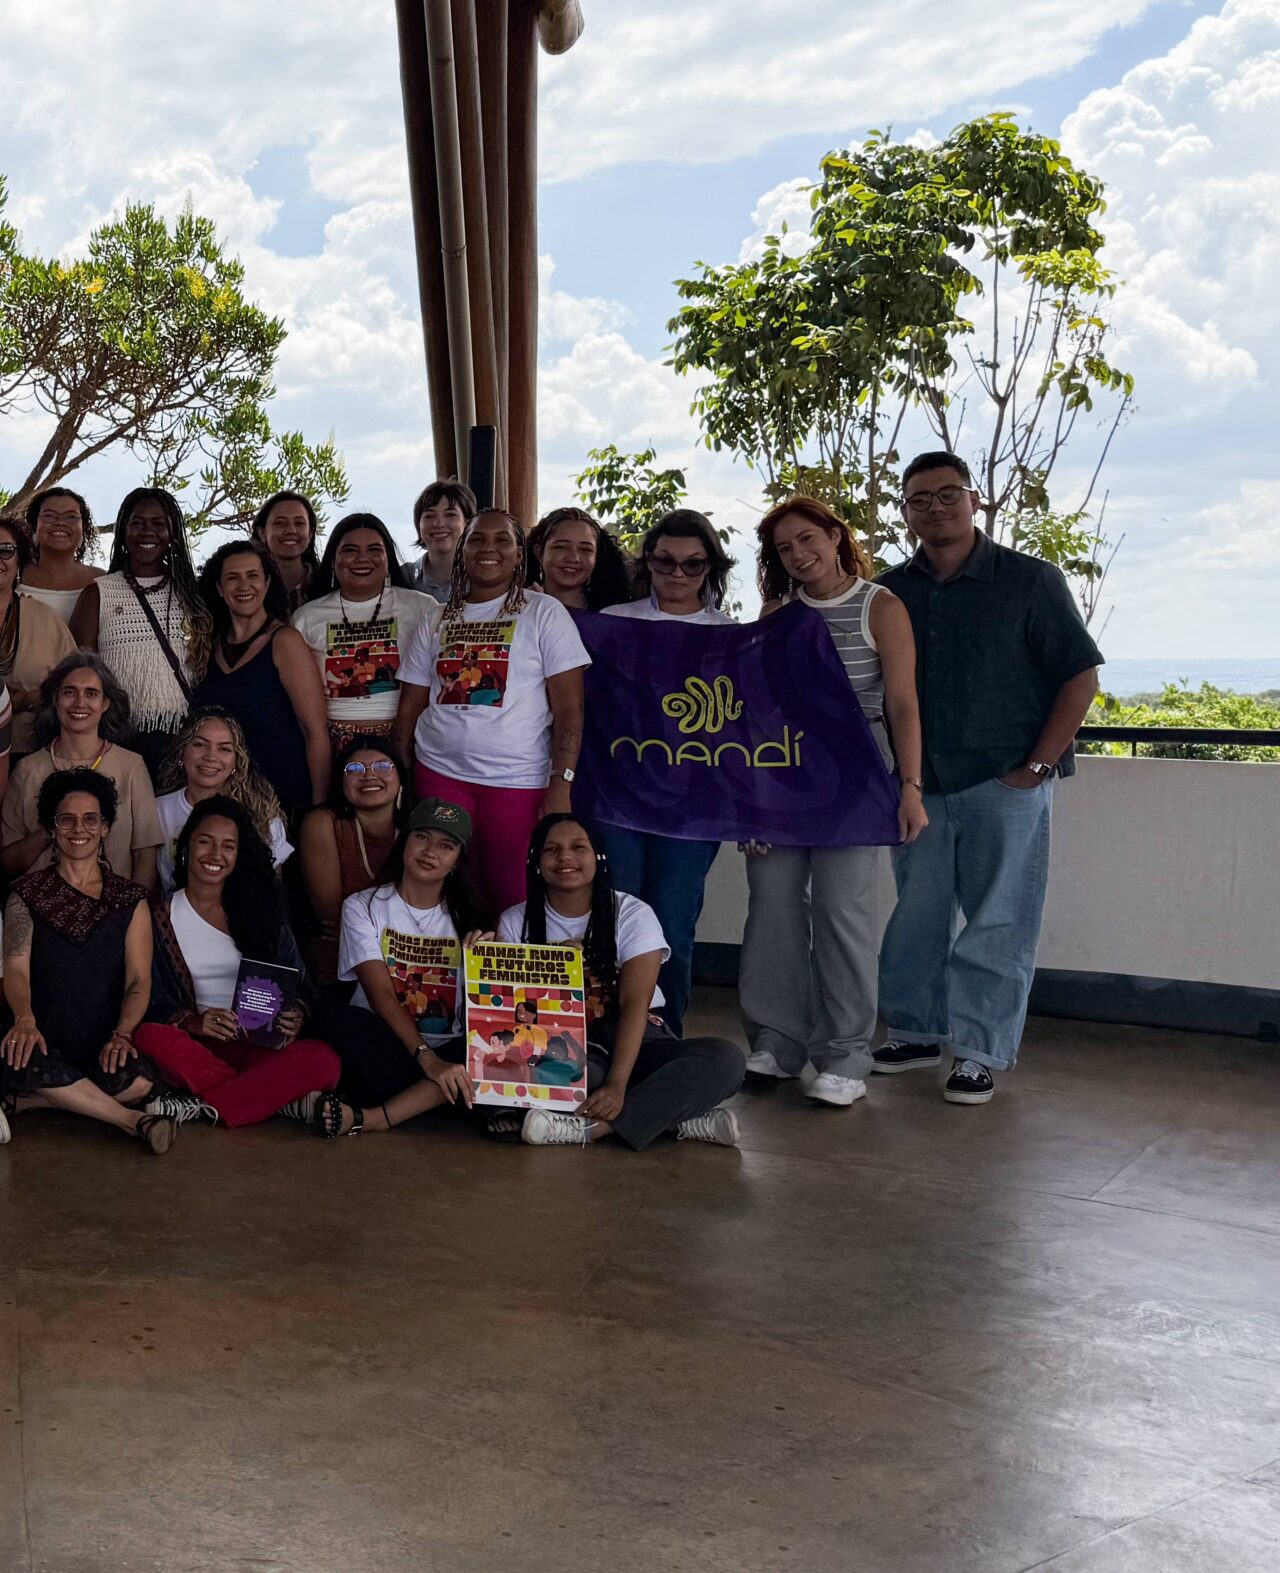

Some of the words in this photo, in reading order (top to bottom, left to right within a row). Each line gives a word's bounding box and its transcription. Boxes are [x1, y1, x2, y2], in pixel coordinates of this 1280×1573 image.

[423, 938, 456, 948] RUMO
[472, 946, 526, 960] MANAS
[529, 949, 575, 962] RUMO
[482, 957, 493, 968] A
[496, 958, 566, 973] FUTUROS
[479, 969, 570, 985] FEMINISTAS
